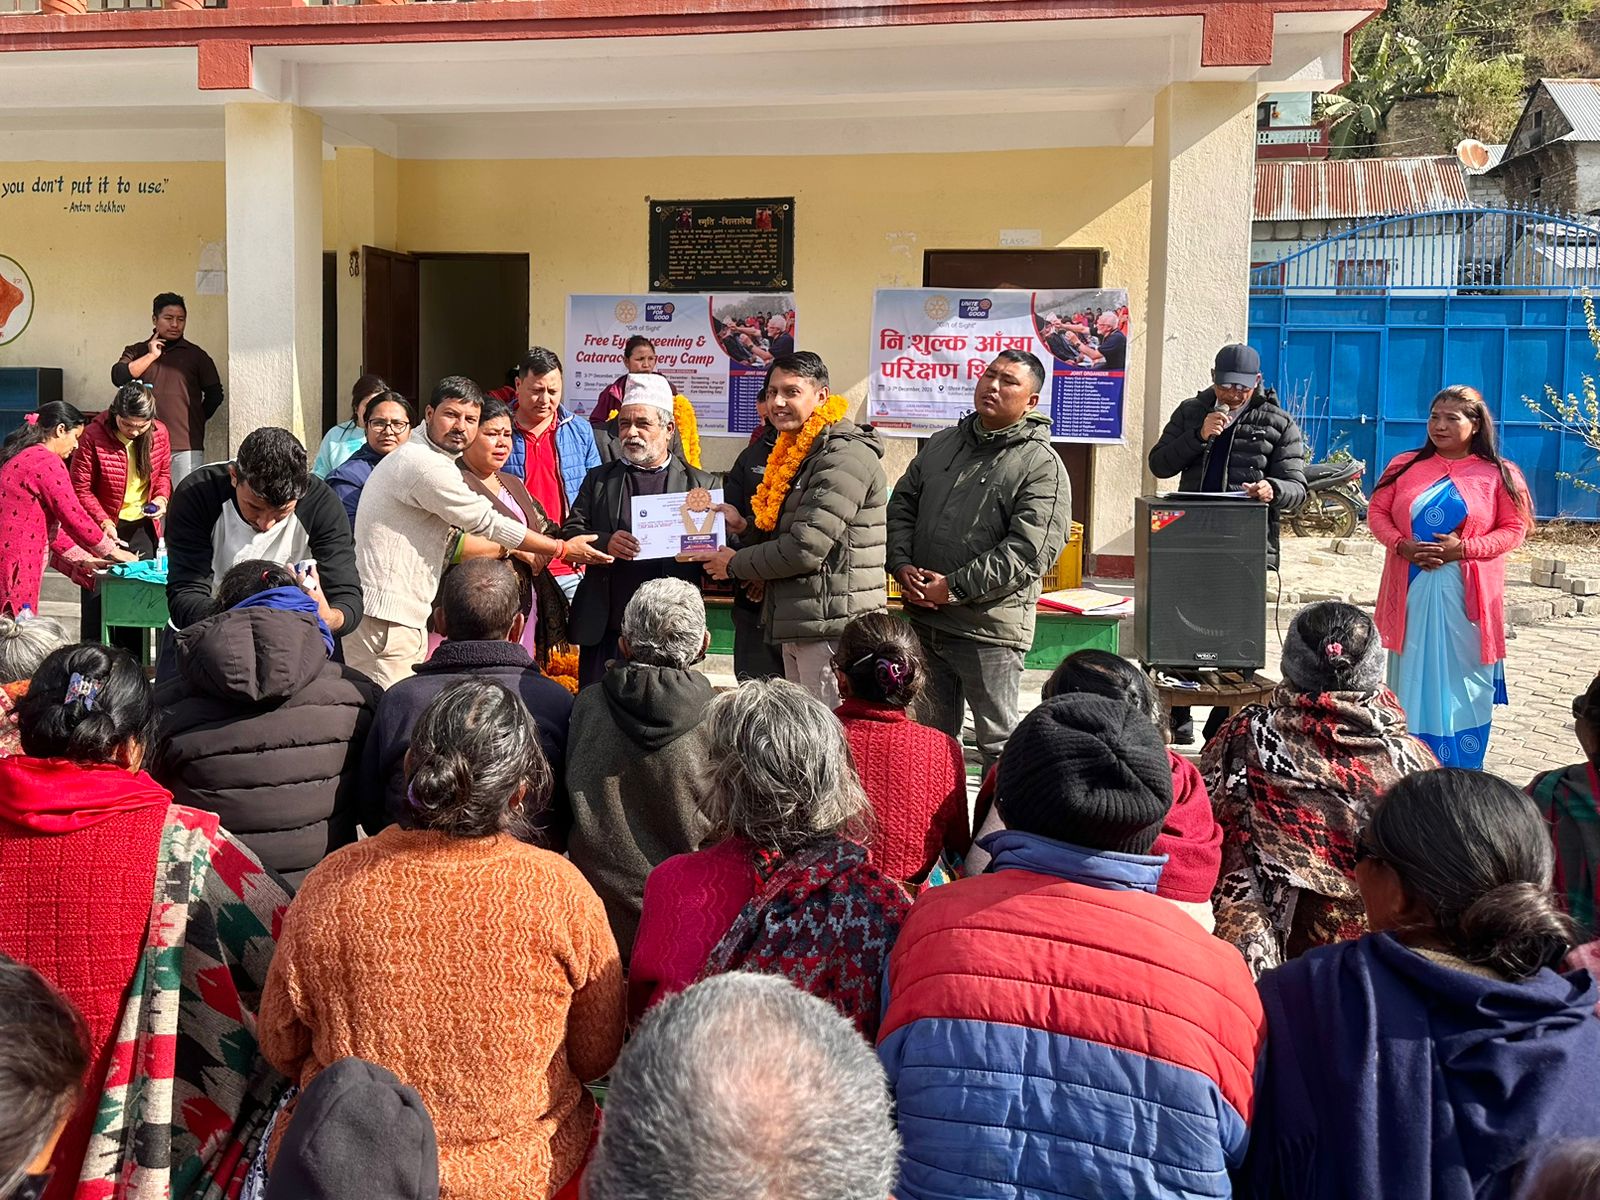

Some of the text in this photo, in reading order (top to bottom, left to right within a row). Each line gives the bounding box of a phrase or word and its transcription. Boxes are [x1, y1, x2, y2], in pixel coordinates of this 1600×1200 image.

[1, 181, 24, 198] you
[32, 175, 64, 193] don't
[71, 175, 93, 196] put
[98, 175, 109, 194] it
[117, 175, 130, 194] to
[584, 334, 610, 346] Free
[650, 335, 694, 350] reening
[696, 335, 706, 347] &
[576, 351, 624, 363] Catarac
[680, 352, 715, 367] Camp
